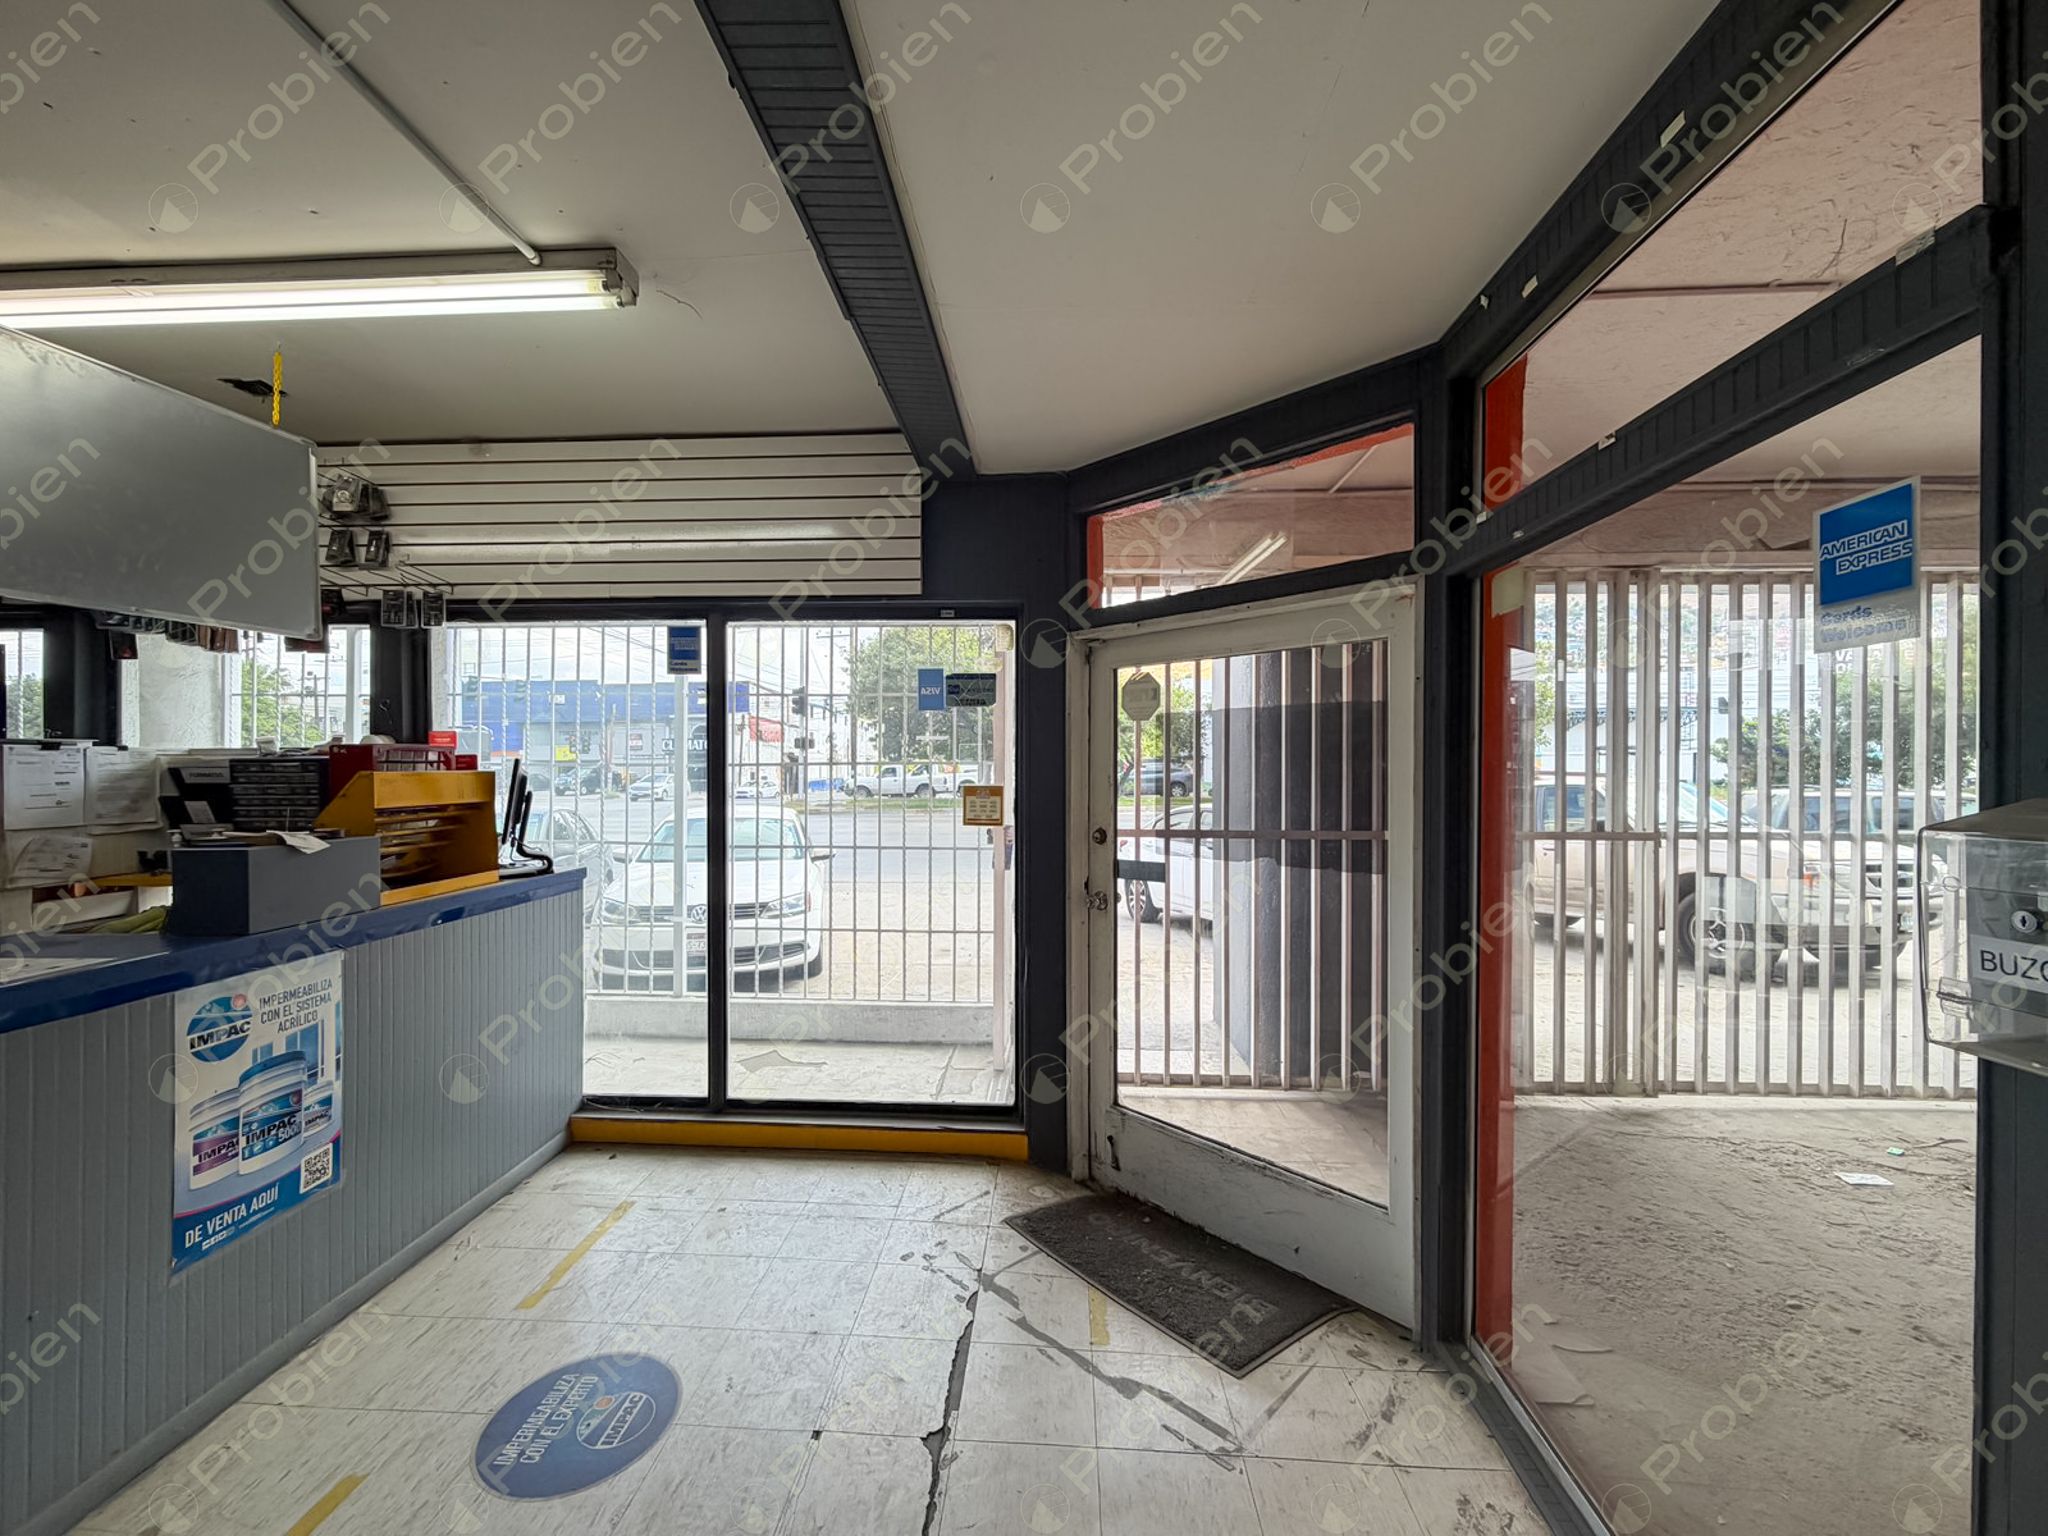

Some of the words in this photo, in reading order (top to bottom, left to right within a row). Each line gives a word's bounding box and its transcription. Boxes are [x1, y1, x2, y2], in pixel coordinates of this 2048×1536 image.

[1820, 520, 1907, 559] AMERICAN
[1836, 542, 1912, 575] EXPRESS
[259, 978, 333, 1010] IMPERMEABILIZA
[260, 1008, 281, 1024] CON
[283, 1004, 293, 1017] EL
[296, 992, 332, 1013] SISTEMA
[189, 1021, 251, 1050] IMPAC
[245, 1114, 297, 1144] IMPAC
[185, 1224, 203, 1248] DE
[206, 1203, 247, 1235] VENTA
[250, 1182, 280, 1213] AQUÍ
[552, 1375, 599, 1421] EXPERTO
[493, 1373, 580, 1466] IMPERMEABILIZA
[542, 1423, 565, 1437] EL
[603, 1393, 645, 1446] IMPAC
[520, 1439, 552, 1464] CON
